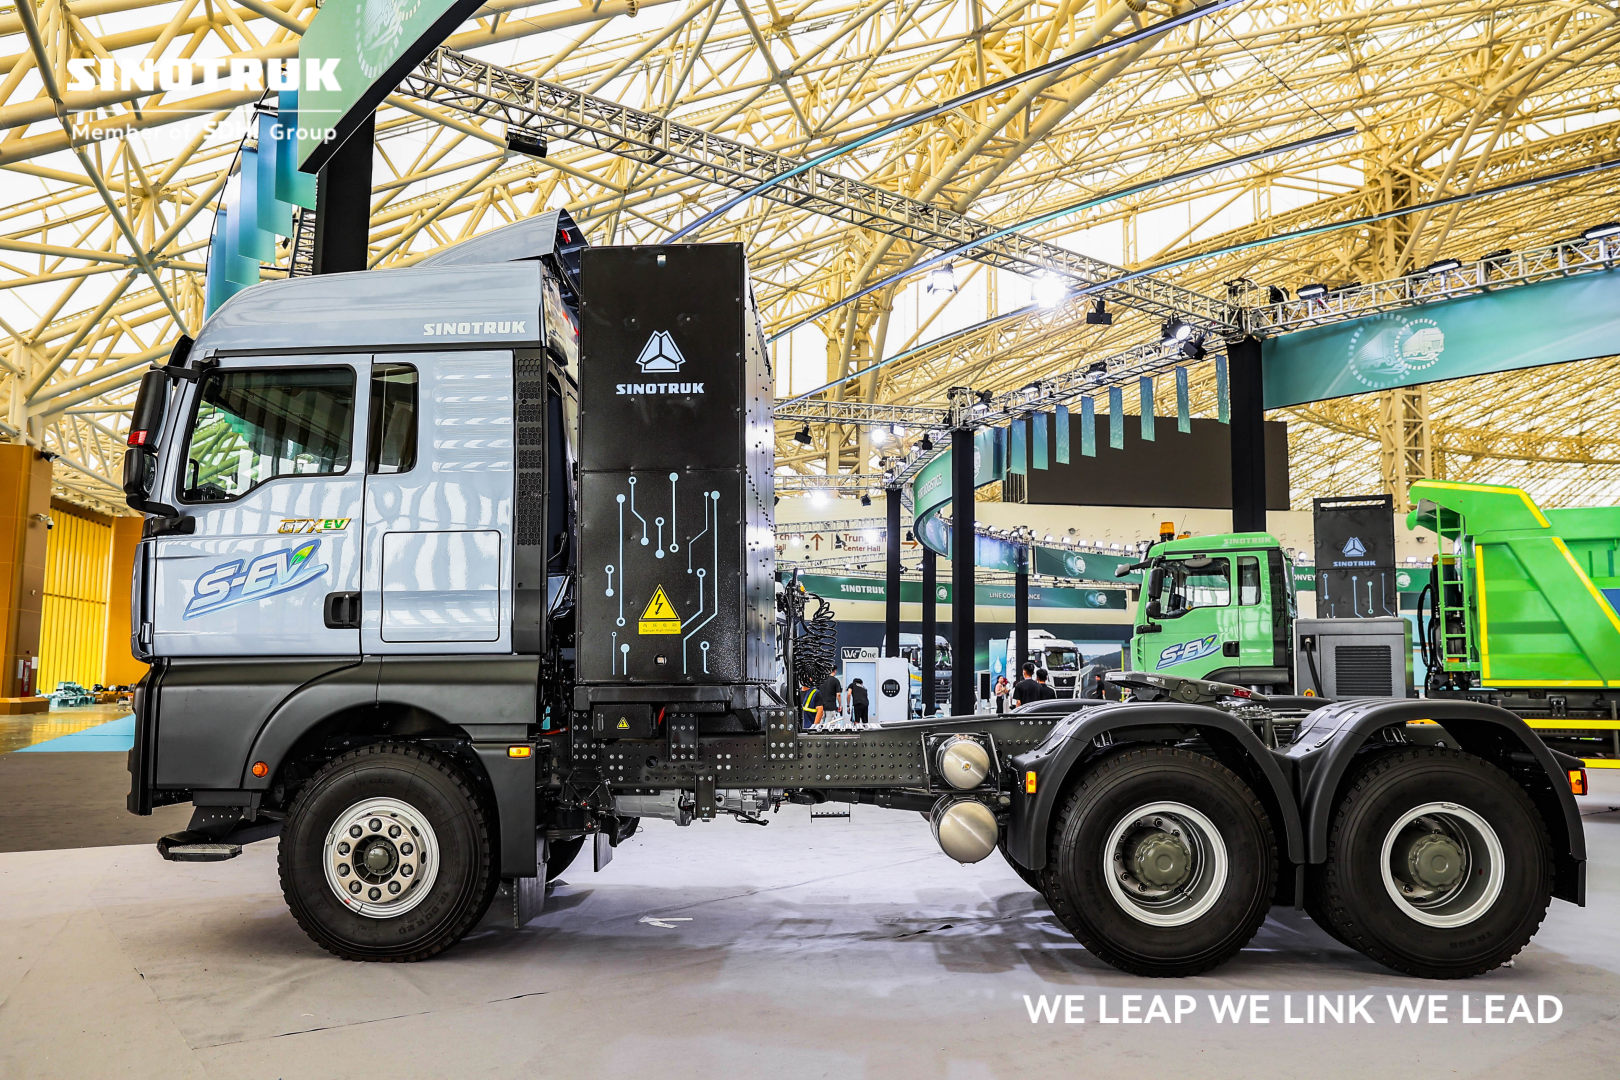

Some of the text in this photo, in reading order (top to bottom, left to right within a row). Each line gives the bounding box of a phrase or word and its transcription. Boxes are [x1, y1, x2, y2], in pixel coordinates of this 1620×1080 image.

[423, 320, 526, 336] SINOTRUK
[615, 382, 705, 395] SINOTRUK
[1223, 536, 1272, 546] SINOTRUK
[185, 540, 320, 614] S-EV
[840, 584, 885, 595] SINOTRUK
[861, 650, 877, 659] One
[1157, 635, 1217, 667] S-EV
